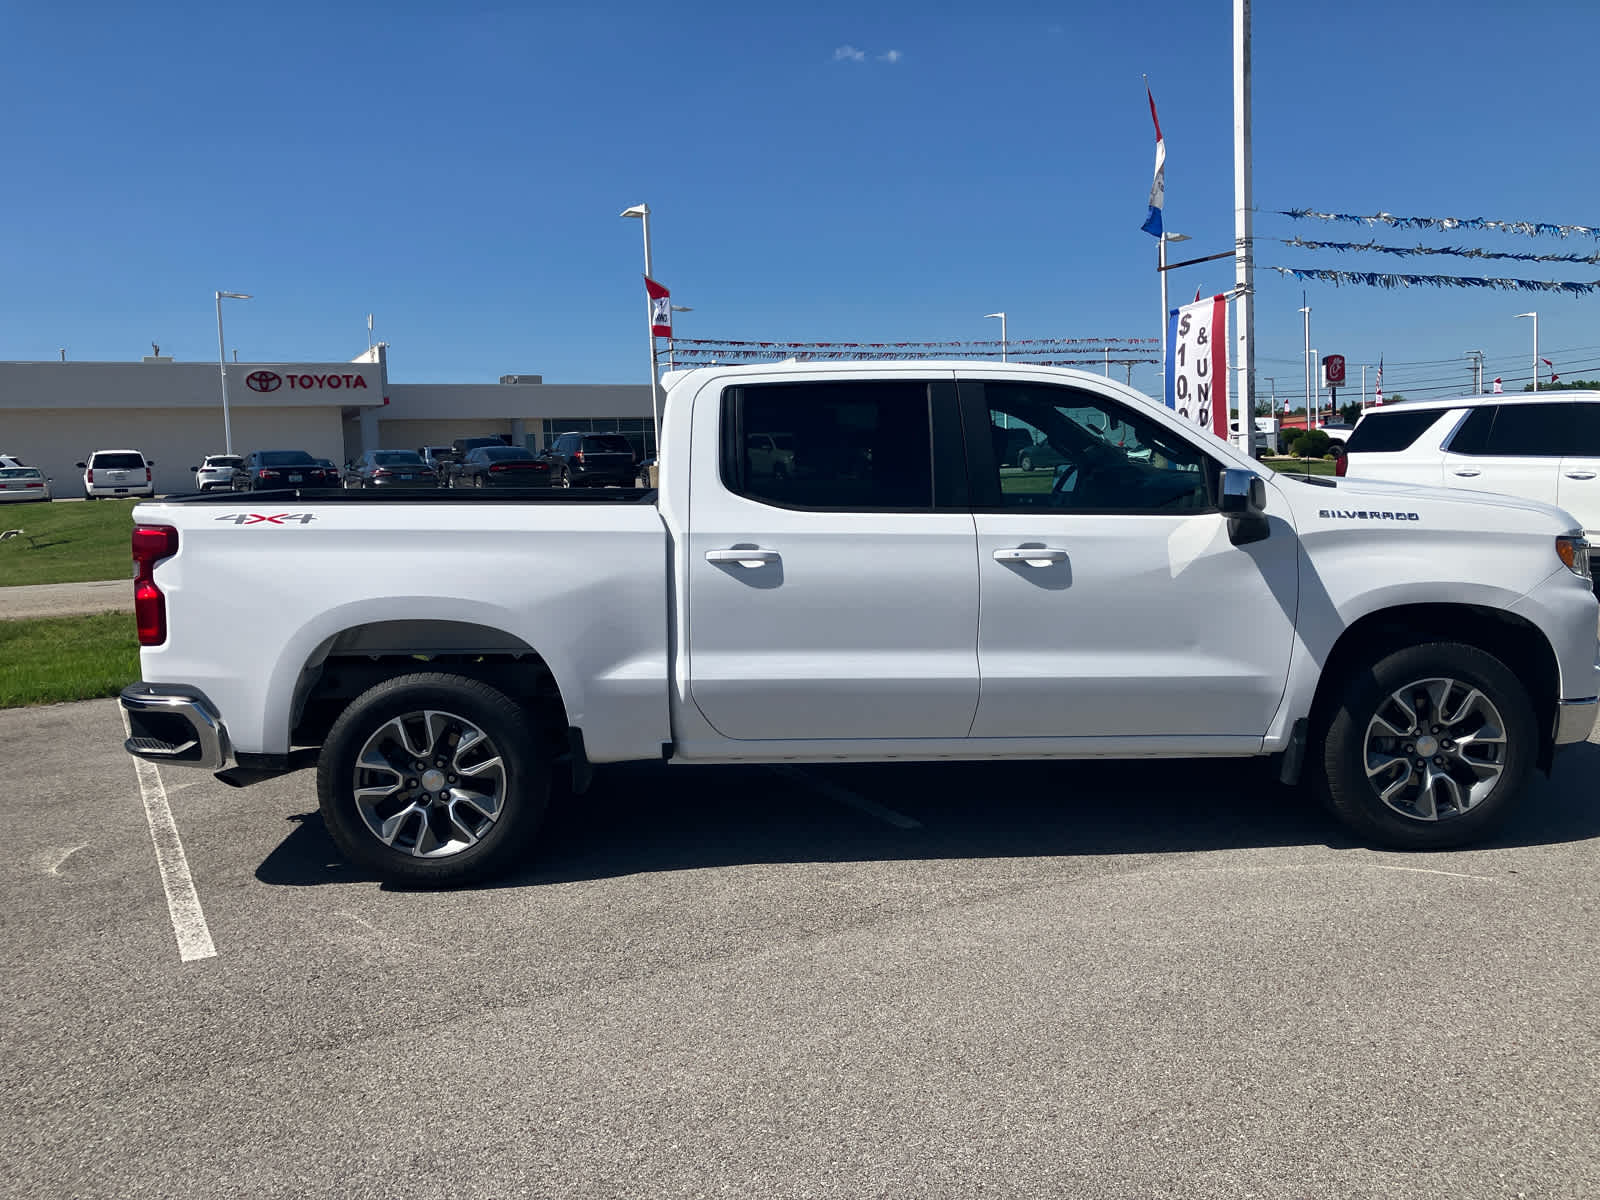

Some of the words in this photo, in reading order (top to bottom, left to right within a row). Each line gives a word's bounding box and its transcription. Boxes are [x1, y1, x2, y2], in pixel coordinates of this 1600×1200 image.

[1197, 326, 1208, 345] &
[286, 374, 367, 389] TOYOTA
[1319, 509, 1420, 521] SILVERADO
